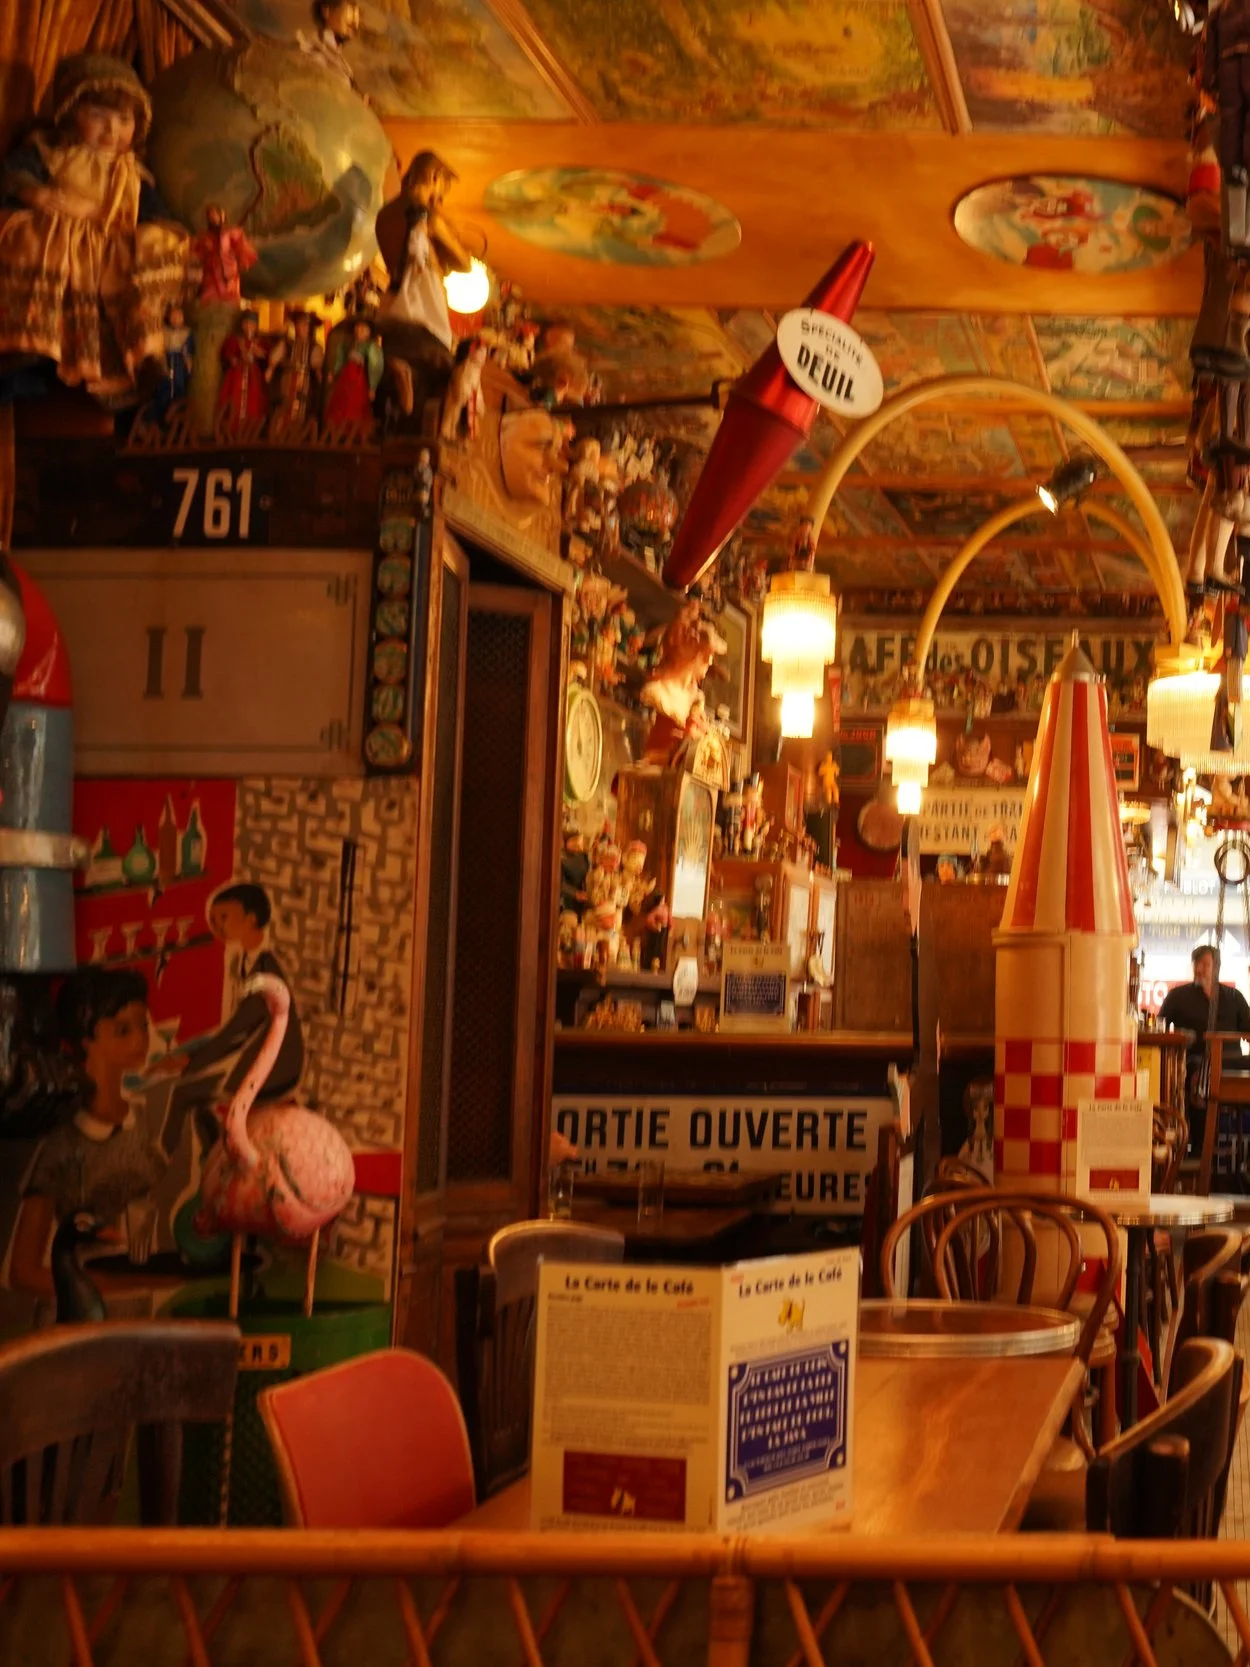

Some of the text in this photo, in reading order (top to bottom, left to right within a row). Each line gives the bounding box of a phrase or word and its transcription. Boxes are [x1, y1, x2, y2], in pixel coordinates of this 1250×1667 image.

[797, 342, 856, 402] DEUIL
[172, 468, 252, 539] 761
[557, 1109, 867, 1151] ORTIE OUVERTE
[779, 1170, 870, 1202] EURE
